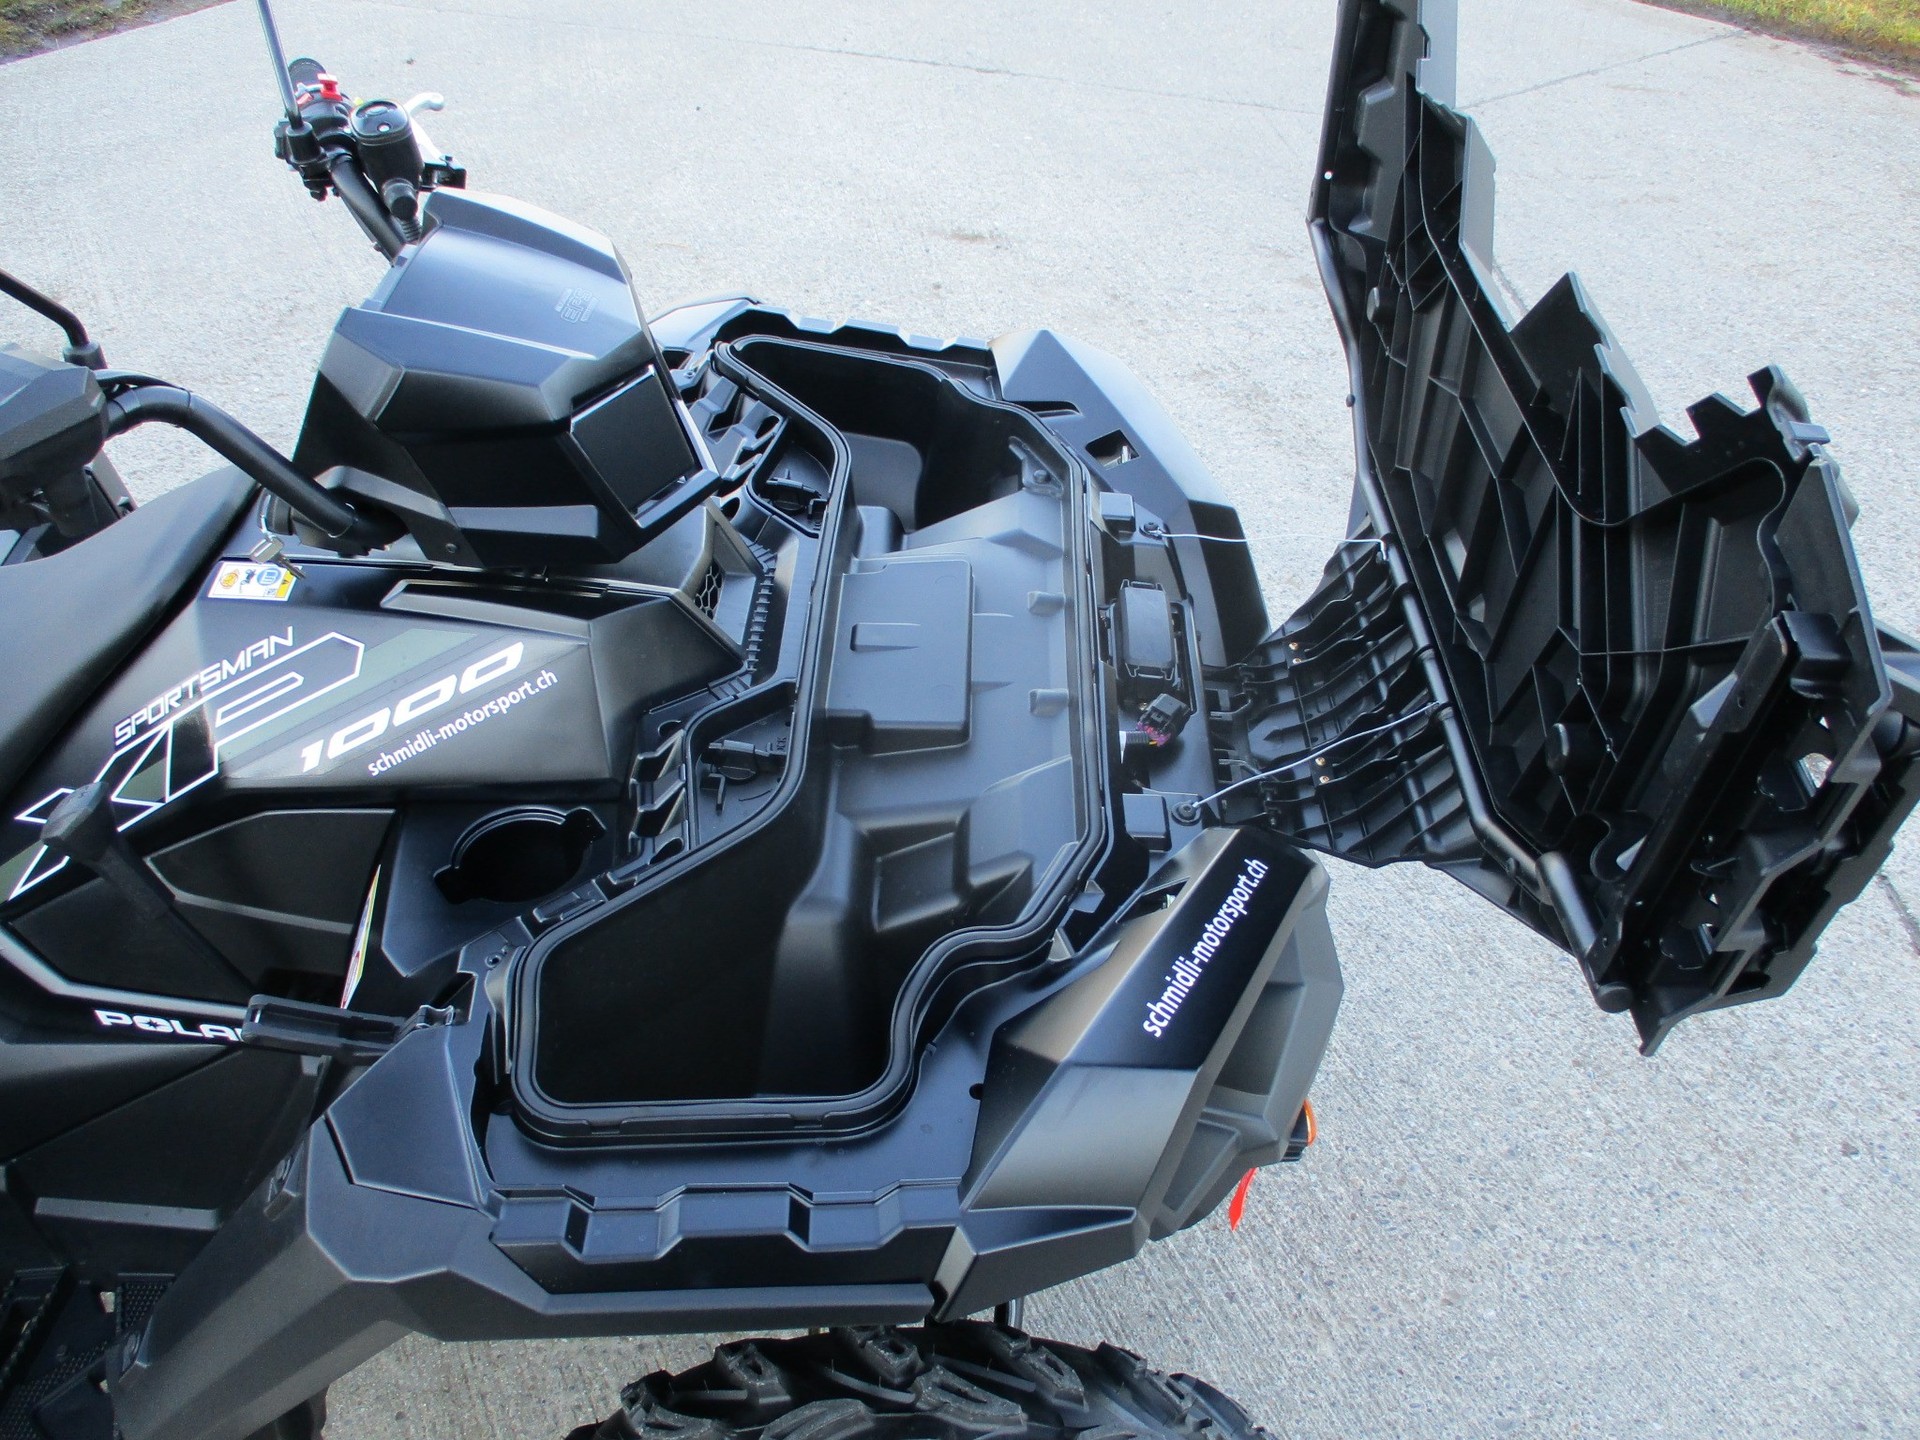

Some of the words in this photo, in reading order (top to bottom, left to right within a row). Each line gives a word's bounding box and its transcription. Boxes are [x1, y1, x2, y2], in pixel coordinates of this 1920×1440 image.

[114, 626, 294, 746] SPORTSMAN
[302, 642, 524, 773] 1000
[367, 669, 558, 776] schmidli-motorsport.ch
[1143, 858, 1268, 1038] schmidli-motorsport.ch
[94, 1009, 243, 1042] POLA
